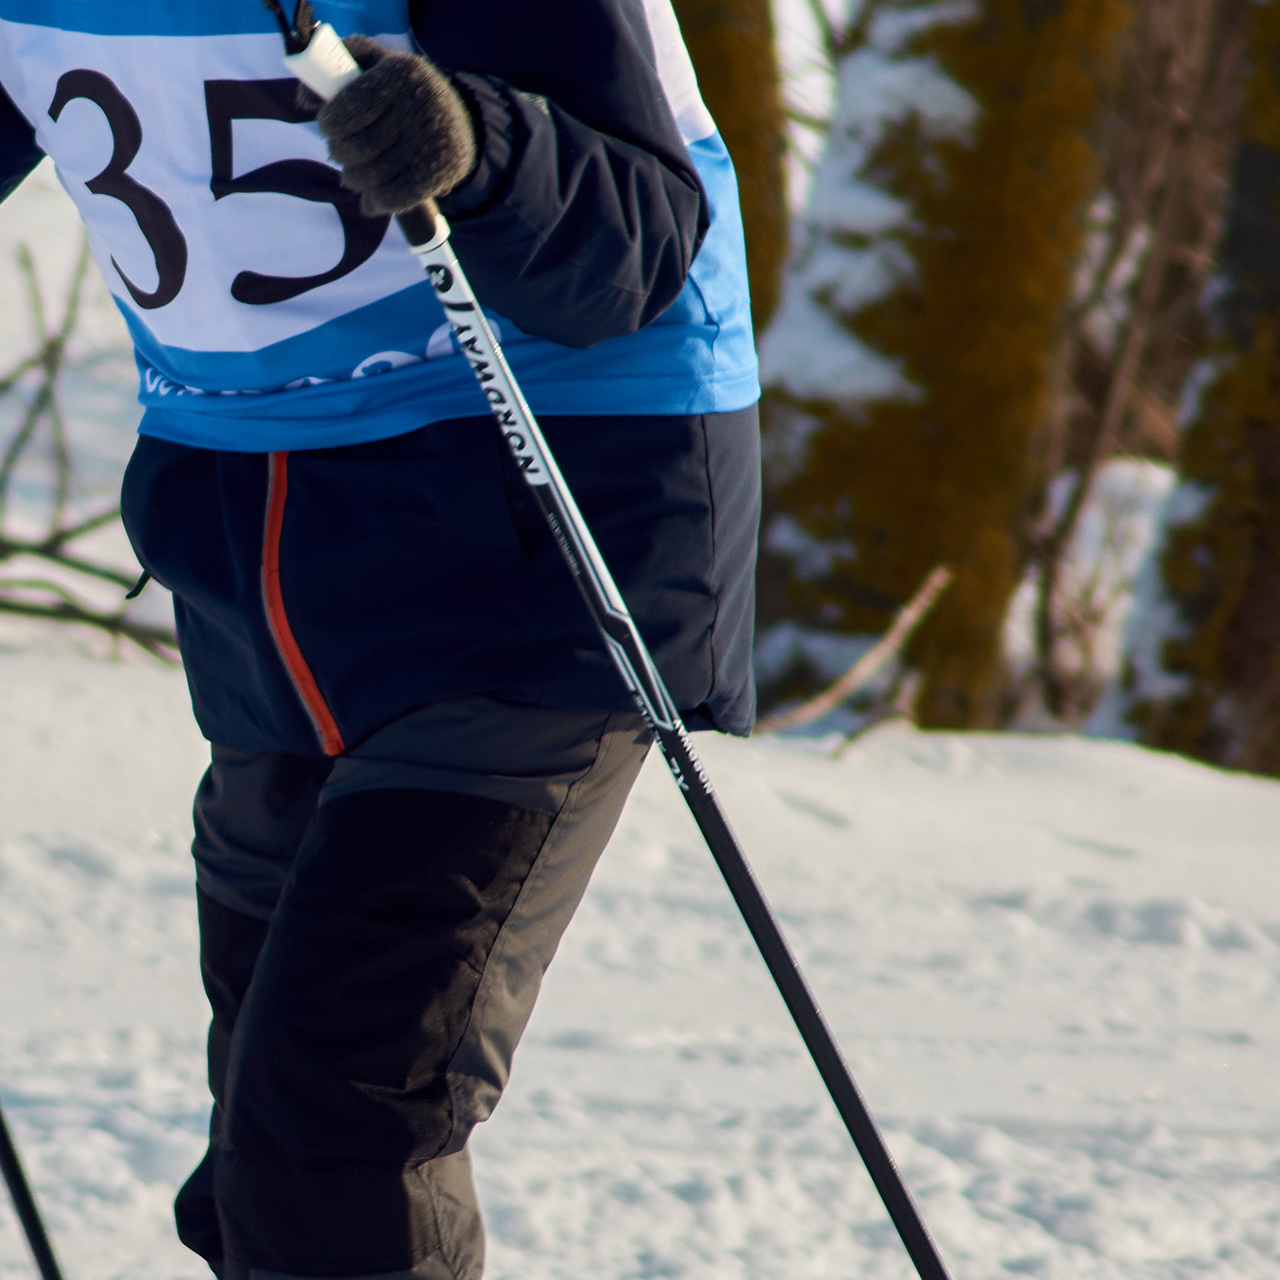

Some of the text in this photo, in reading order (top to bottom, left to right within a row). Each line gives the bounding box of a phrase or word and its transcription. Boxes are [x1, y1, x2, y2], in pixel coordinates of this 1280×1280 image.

[47, 68, 393, 310] 35
[453, 324, 541, 475] NORDWAY
[673, 718, 714, 795] NORDWAY
